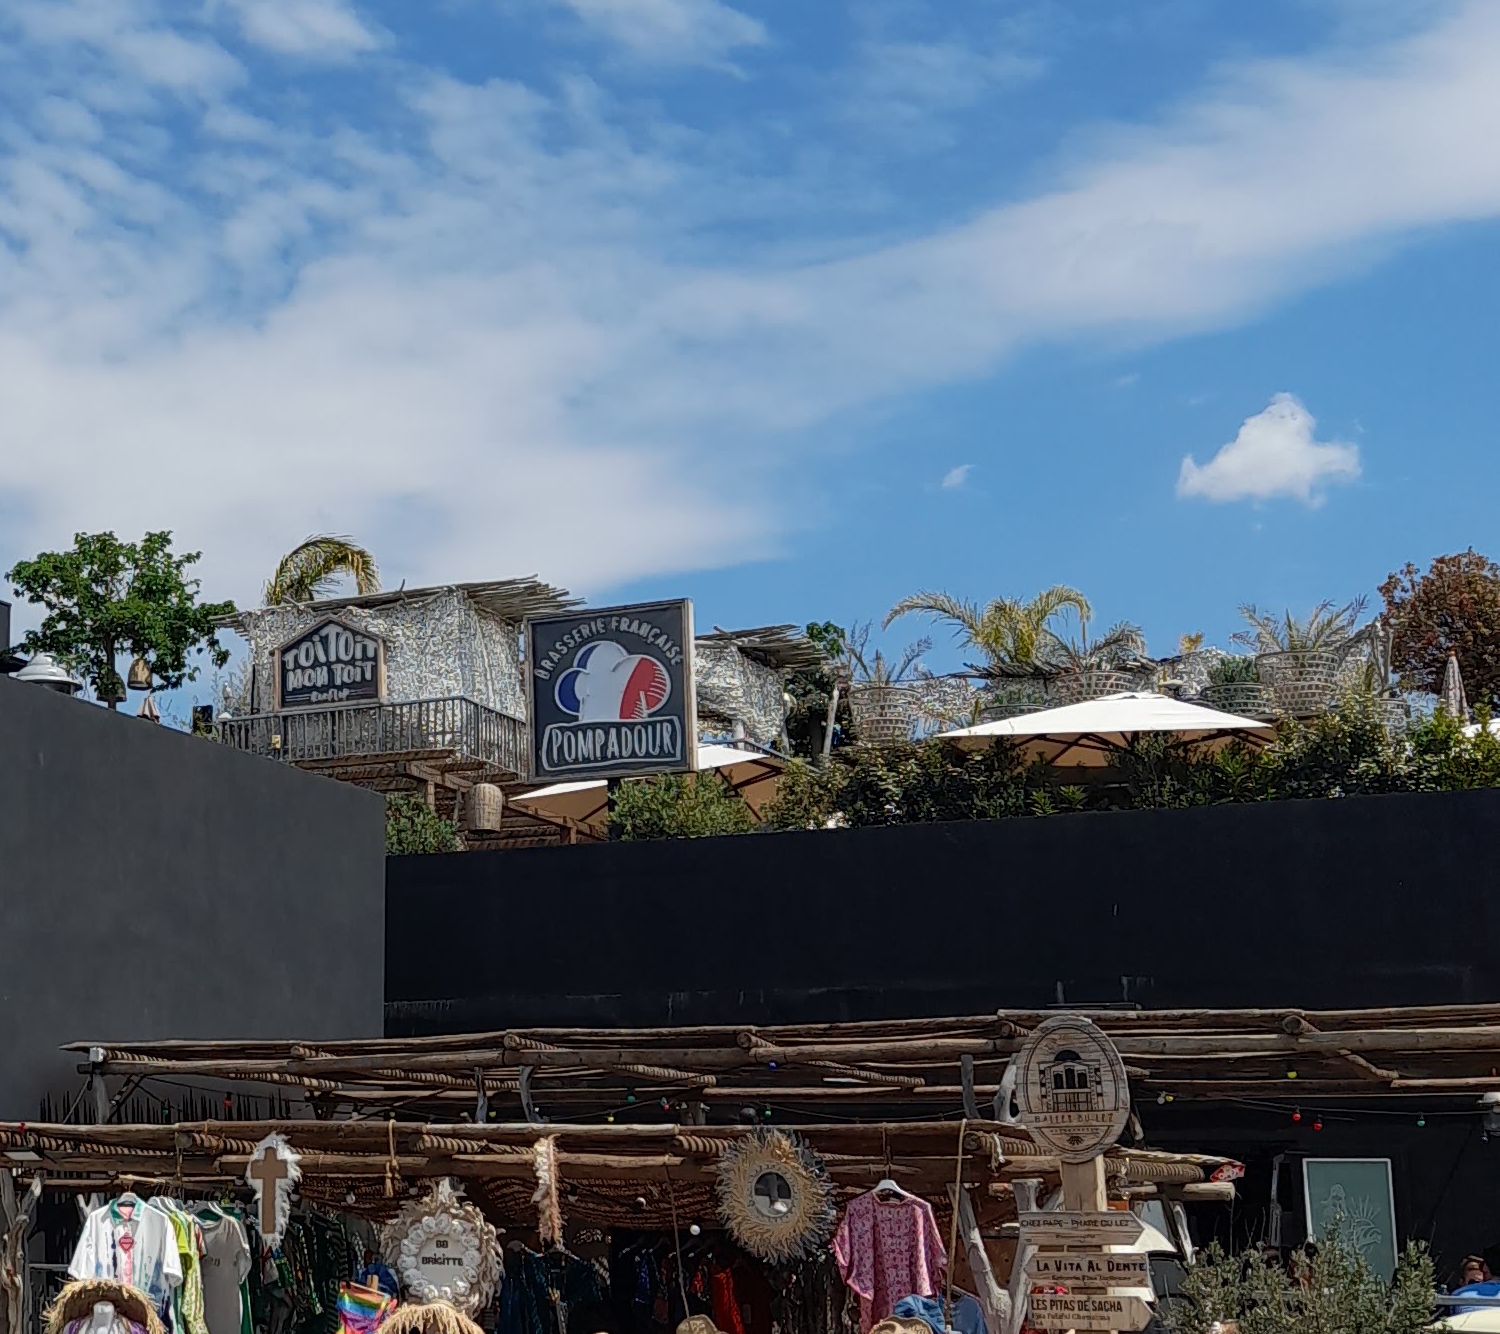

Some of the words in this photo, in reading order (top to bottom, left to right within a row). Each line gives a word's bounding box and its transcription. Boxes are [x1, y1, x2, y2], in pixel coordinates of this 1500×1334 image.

[534, 618, 606, 680] BRASSERIE
[551, 721, 674, 764] POMPADOUR
[1031, 1298, 1048, 1311] LES
[1049, 1299, 1076, 1312] PITAS
[1077, 1299, 1090, 1312] DE
[1091, 1299, 1123, 1313] SACHA
